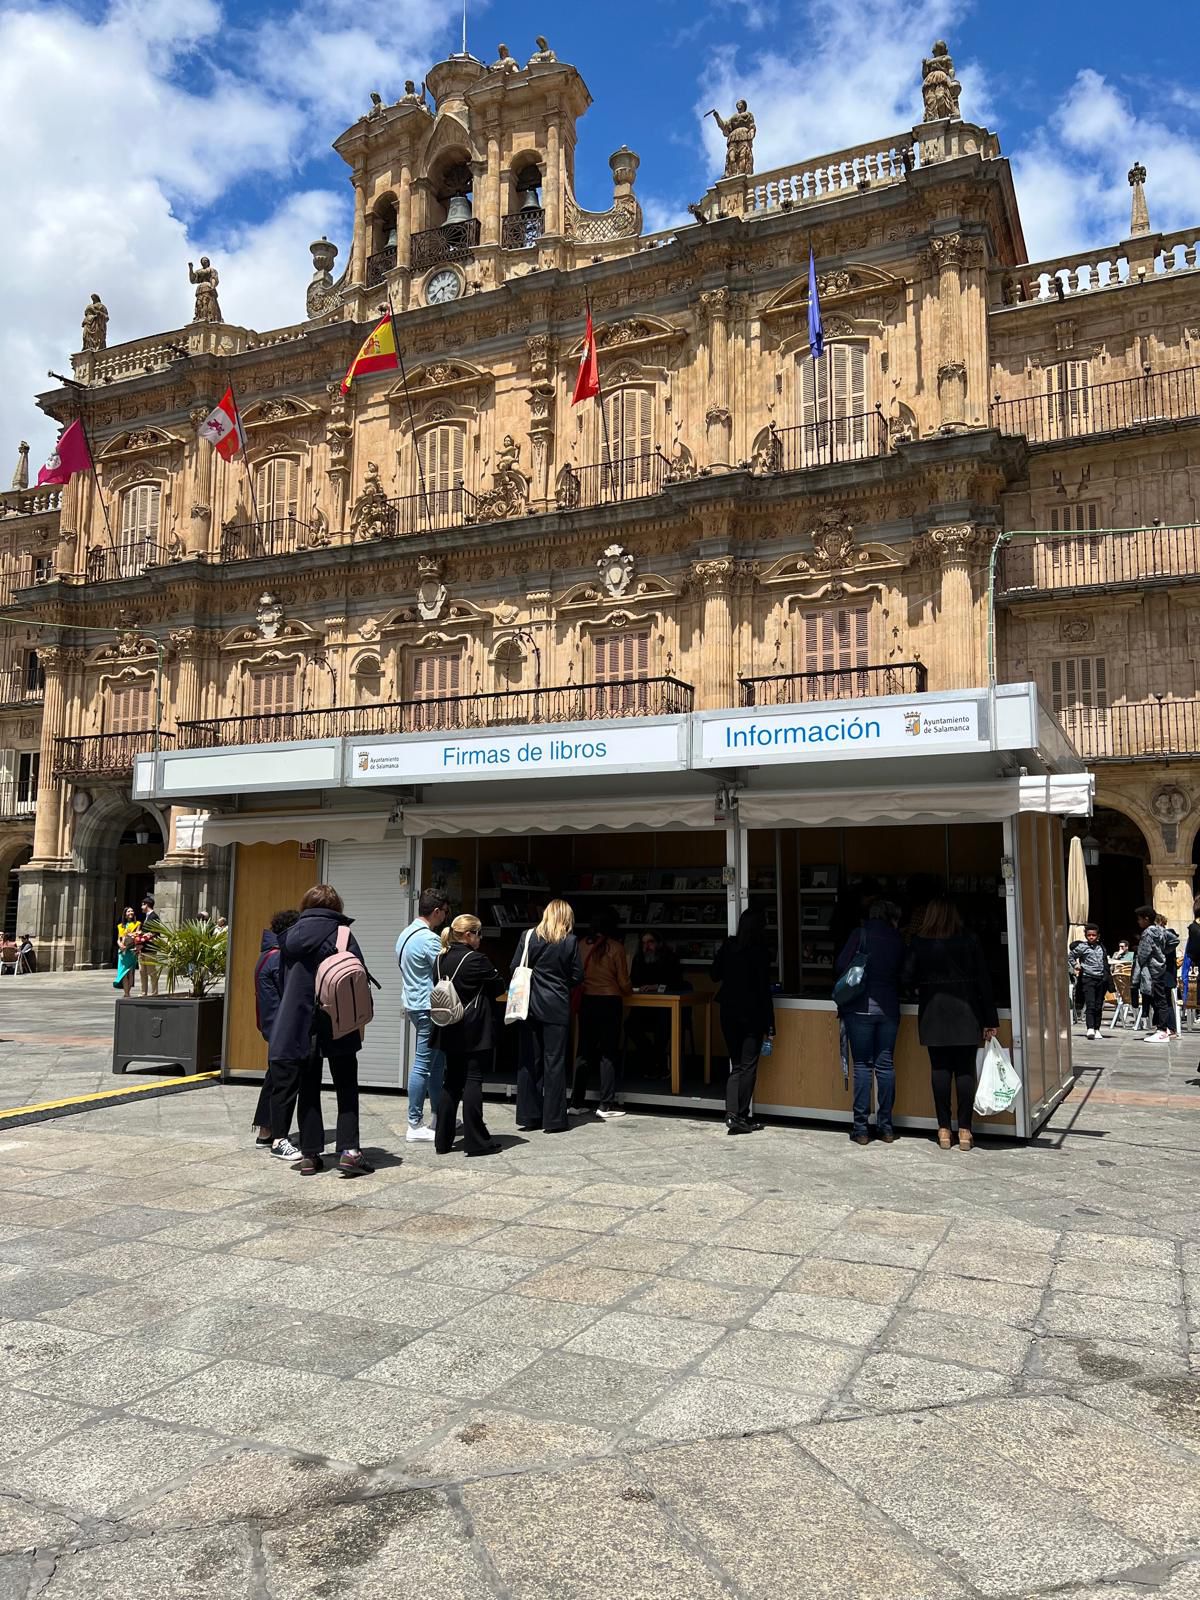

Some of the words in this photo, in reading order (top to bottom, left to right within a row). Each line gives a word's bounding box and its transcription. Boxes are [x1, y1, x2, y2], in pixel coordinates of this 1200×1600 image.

[924, 716, 970, 726] Ayuntamiento
[934, 725, 970, 733] Salamanca
[726, 717, 880, 747] Información
[443, 747, 511, 766] Firmas
[517, 742, 542, 762] de
[550, 740, 607, 760] libros
